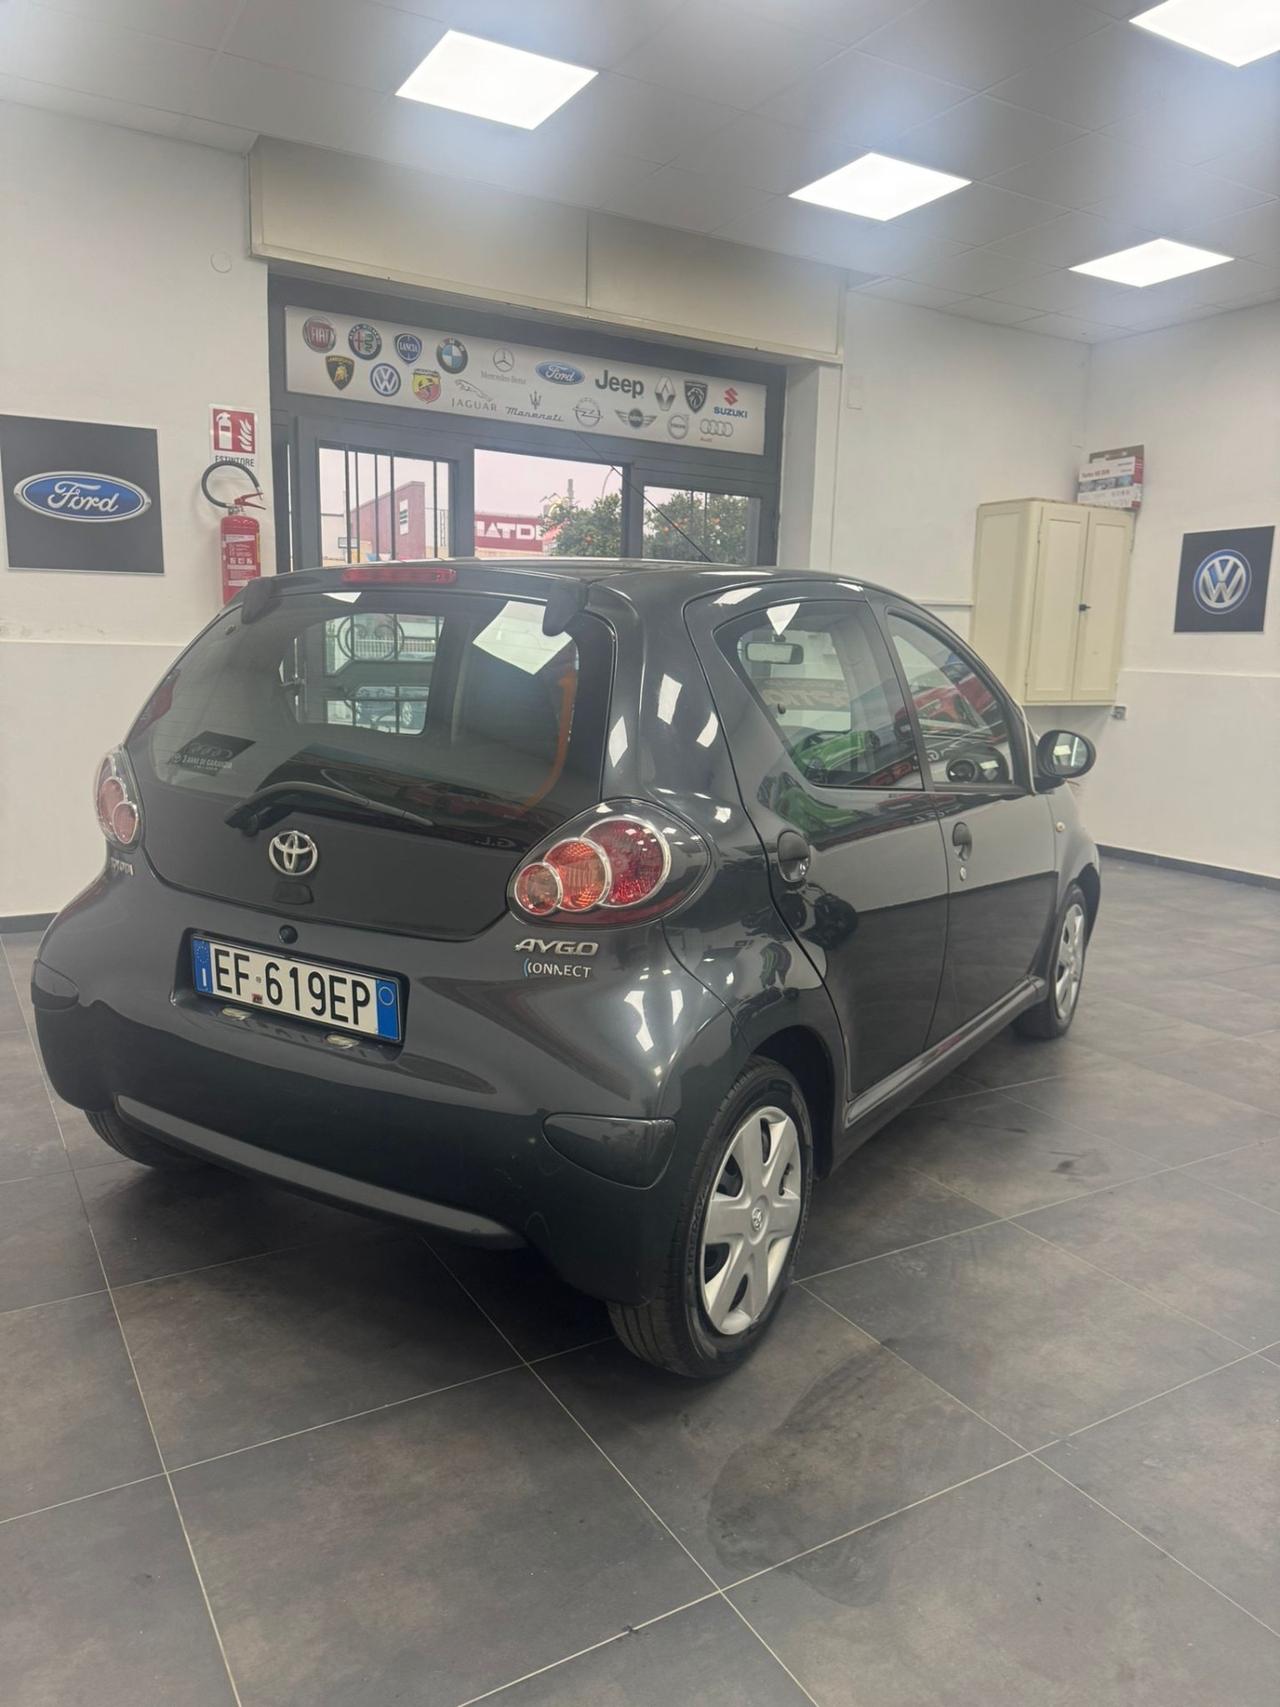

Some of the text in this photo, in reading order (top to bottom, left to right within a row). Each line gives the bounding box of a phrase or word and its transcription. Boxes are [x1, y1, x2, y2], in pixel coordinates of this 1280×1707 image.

[311, 327, 333, 342] FIAT
[399, 340, 418, 352] LANCIA
[544, 362, 575, 382] Ford
[595, 369, 645, 399] Jeep
[451, 398, 497, 412] JAGUAR
[713, 406, 749, 419] SUZUKI
[47, 480, 120, 513] Ford
[513, 938, 599, 956] AYGO
[523, 957, 592, 979] CONNECT
[214, 948, 251, 996] EF
[265, 961, 371, 1026] 619EP
